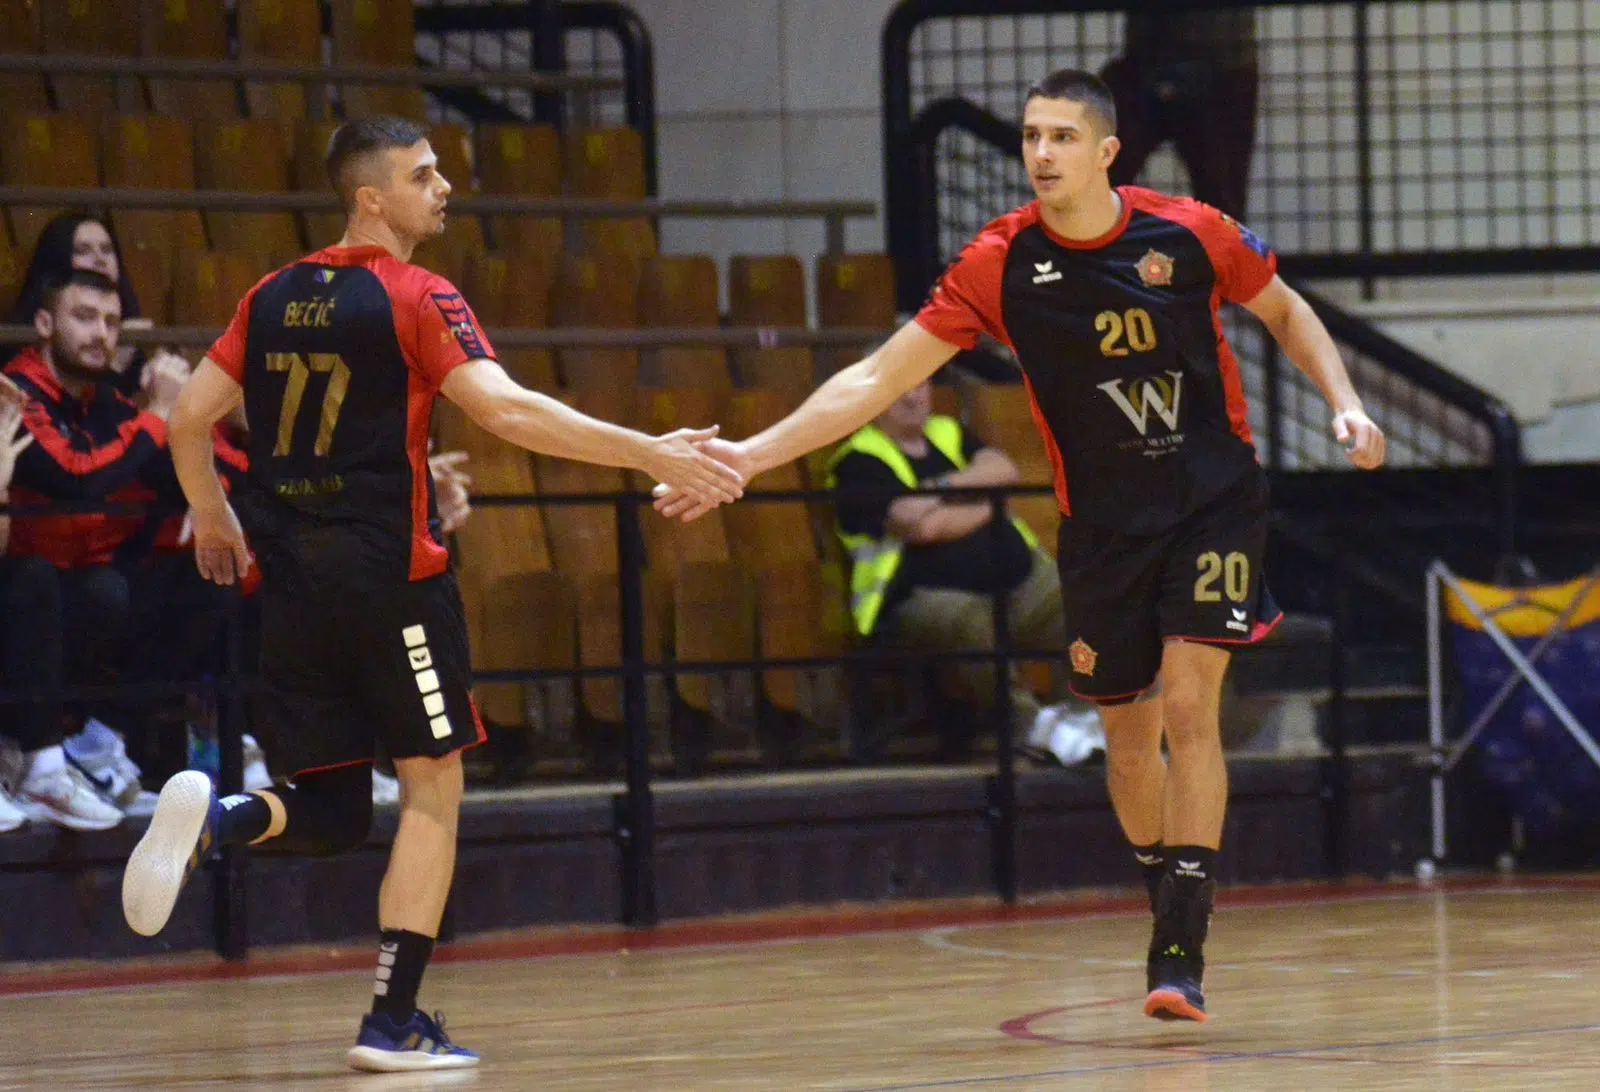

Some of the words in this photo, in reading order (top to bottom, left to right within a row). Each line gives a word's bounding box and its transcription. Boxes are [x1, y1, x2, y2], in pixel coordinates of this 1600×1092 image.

[1095, 308, 1157, 357] 20
[265, 352, 351, 456] 77
[1194, 551, 1250, 603] 20
